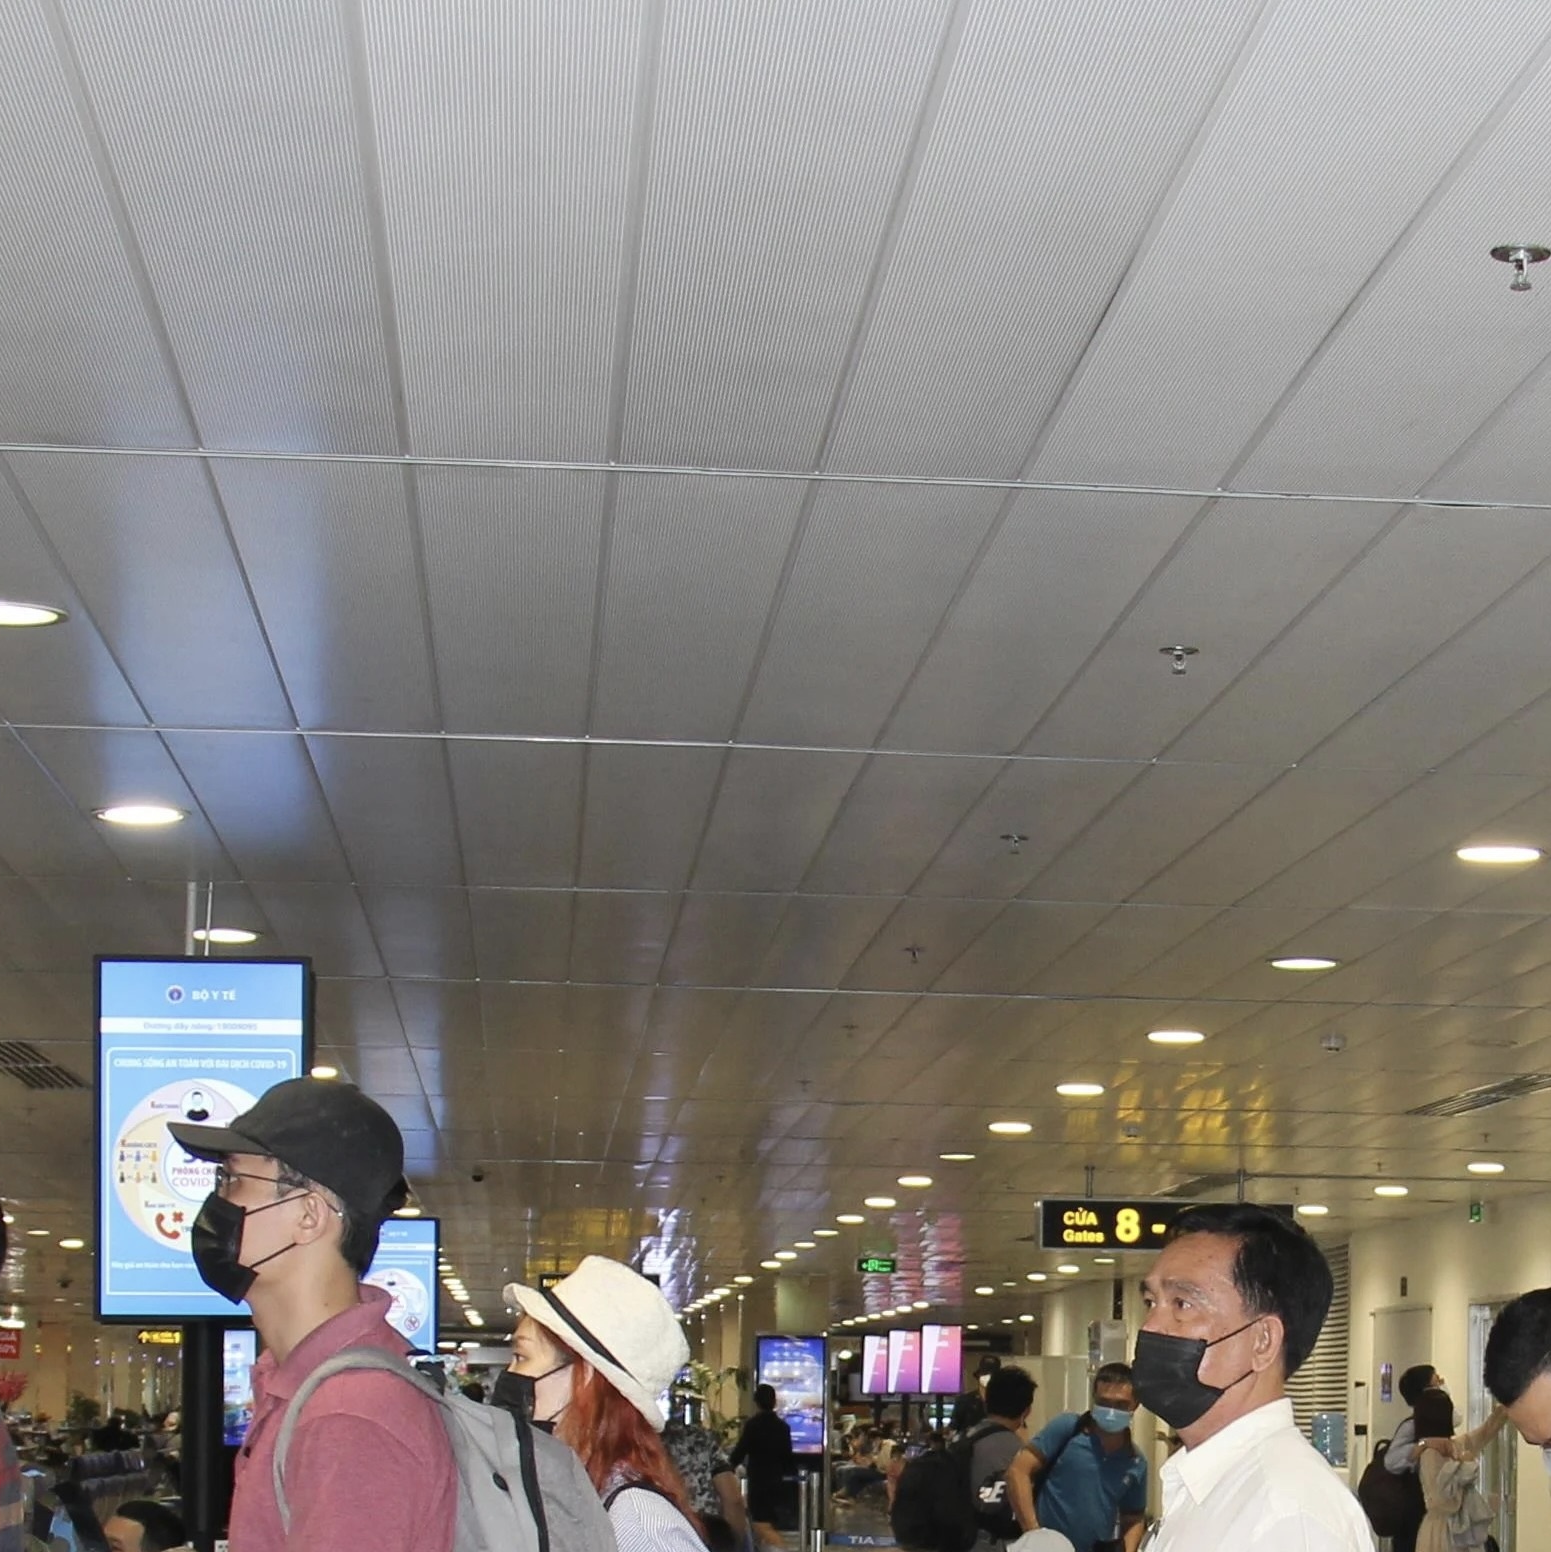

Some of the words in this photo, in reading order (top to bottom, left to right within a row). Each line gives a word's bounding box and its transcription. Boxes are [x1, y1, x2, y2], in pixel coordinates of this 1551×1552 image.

[212, 990, 220, 1000] Y
[222, 988, 236, 1000] TẾ
[250, 1060, 288, 1070] COVID-19
[1063, 1206, 1098, 1226] CỬA
[1115, 1208, 1141, 1243] 8
[1062, 1229, 1105, 1244] Gates
[848, 1534, 875, 1545] TIA
